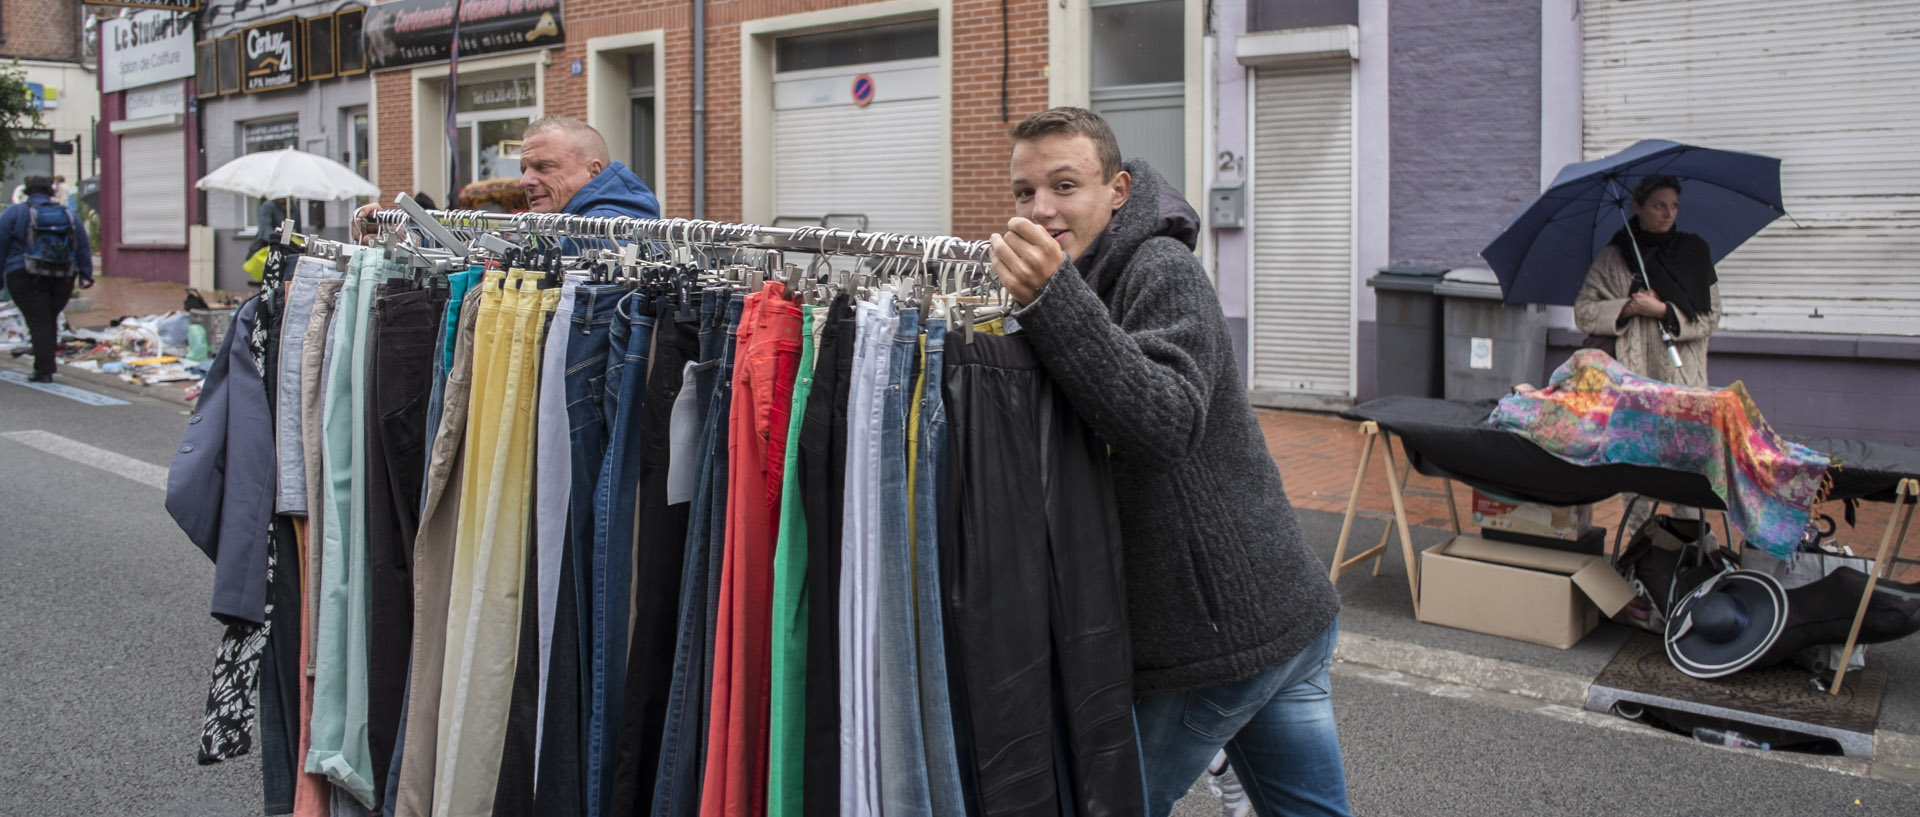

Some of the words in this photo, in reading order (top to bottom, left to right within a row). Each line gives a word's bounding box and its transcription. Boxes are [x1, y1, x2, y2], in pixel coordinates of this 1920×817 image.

[114, 26, 128, 51] Le
[247, 28, 284, 59] Century
[400, 45, 437, 59] Talons
[482, 31, 524, 47] minute
[120, 61, 137, 74] Salon
[140, 58, 149, 71] de
[151, 50, 180, 69] Coiffure
[279, 40, 292, 71] 21
[1219, 150, 1244, 177] 21
